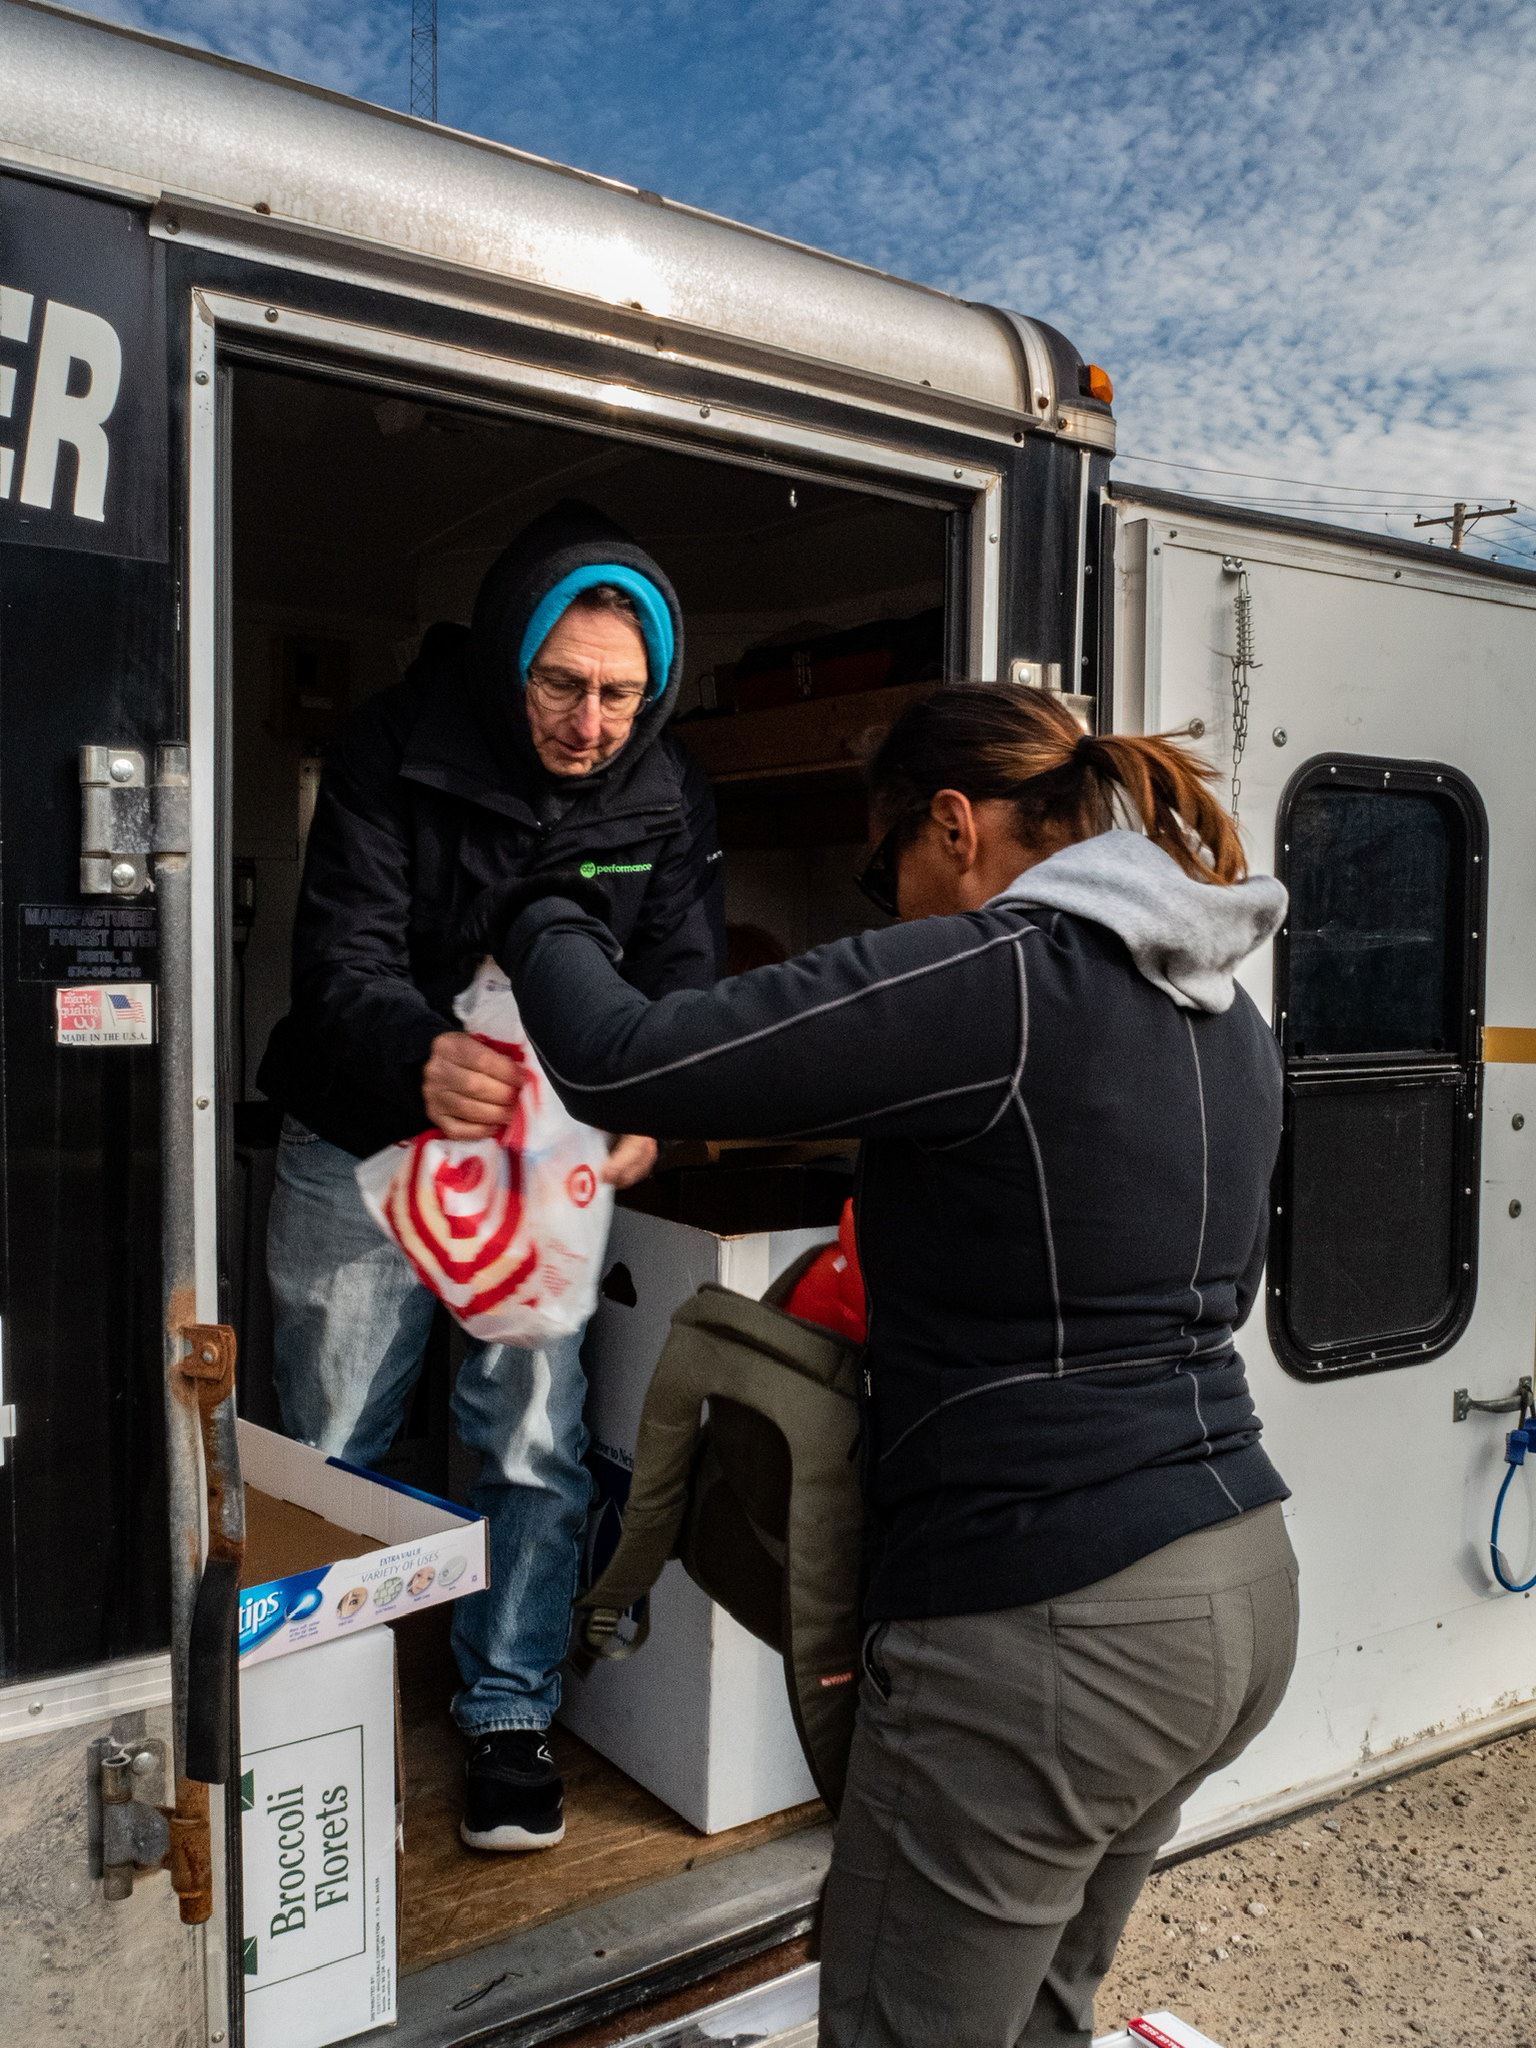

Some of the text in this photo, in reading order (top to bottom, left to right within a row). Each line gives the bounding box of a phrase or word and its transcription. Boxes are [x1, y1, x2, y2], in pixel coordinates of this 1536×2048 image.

[597, 863, 653, 875] performance
[49, 928, 110, 946] FOREST
[62, 1032, 148, 1042] MADE IN THE U.S.A.
[380, 1547, 422, 1567] EXTRA VALUE
[361, 1552, 439, 1583] VARIETY OF USES
[315, 1784, 349, 1912] Florets
[267, 1785, 306, 1939] Broccoli
